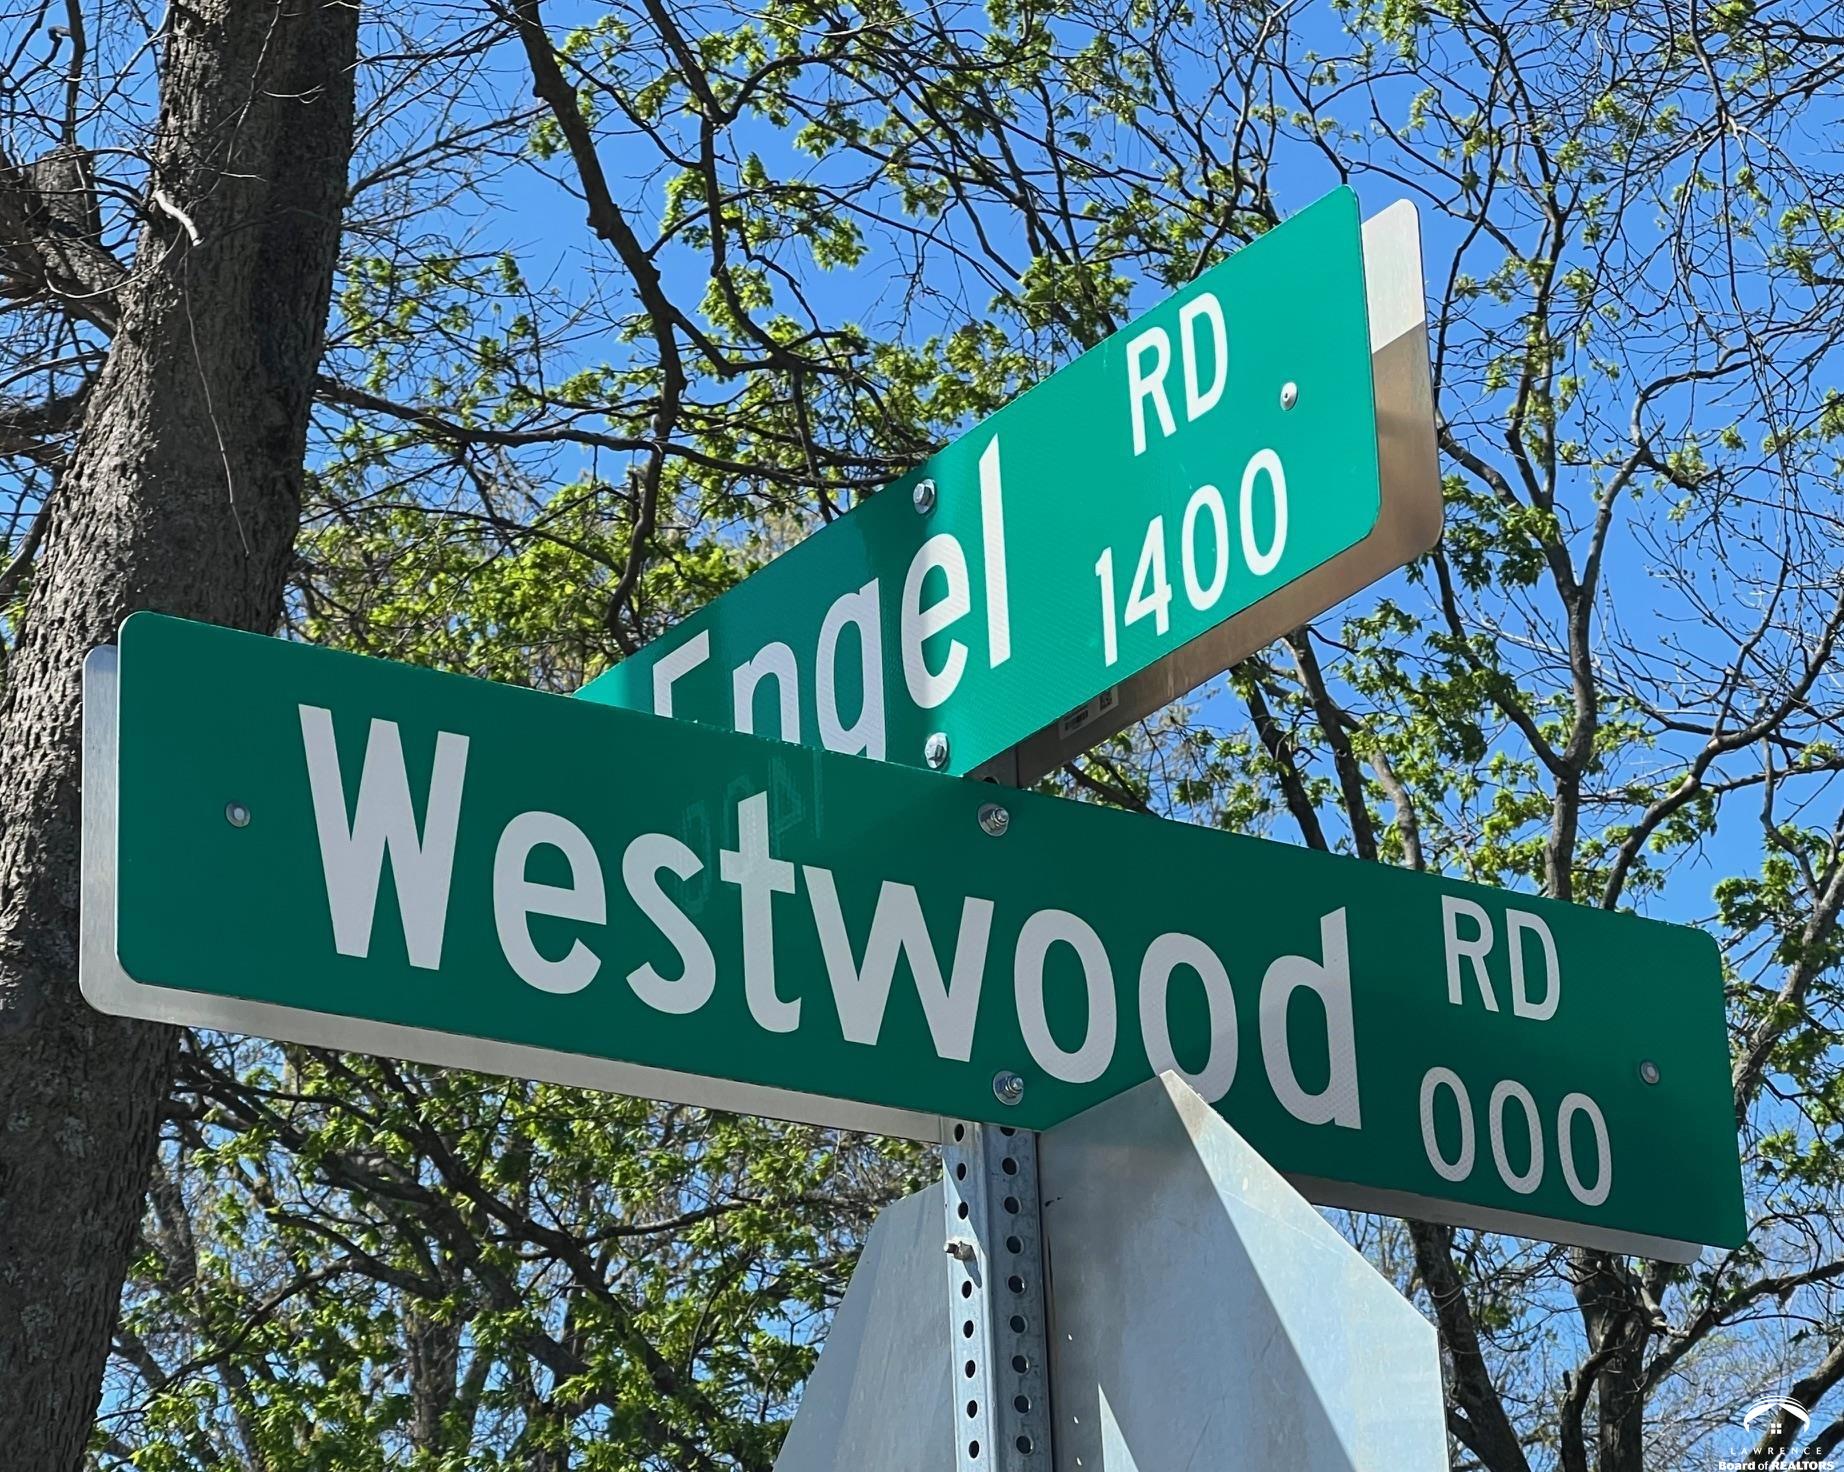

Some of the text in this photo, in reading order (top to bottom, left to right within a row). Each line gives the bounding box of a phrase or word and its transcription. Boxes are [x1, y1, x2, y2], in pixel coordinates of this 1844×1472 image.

[1126, 292, 1228, 456] RD
[1095, 448, 1288, 666] 1400
[298, 704, 1560, 1130] Westwood RD
[1419, 1066, 1612, 1206] 000
